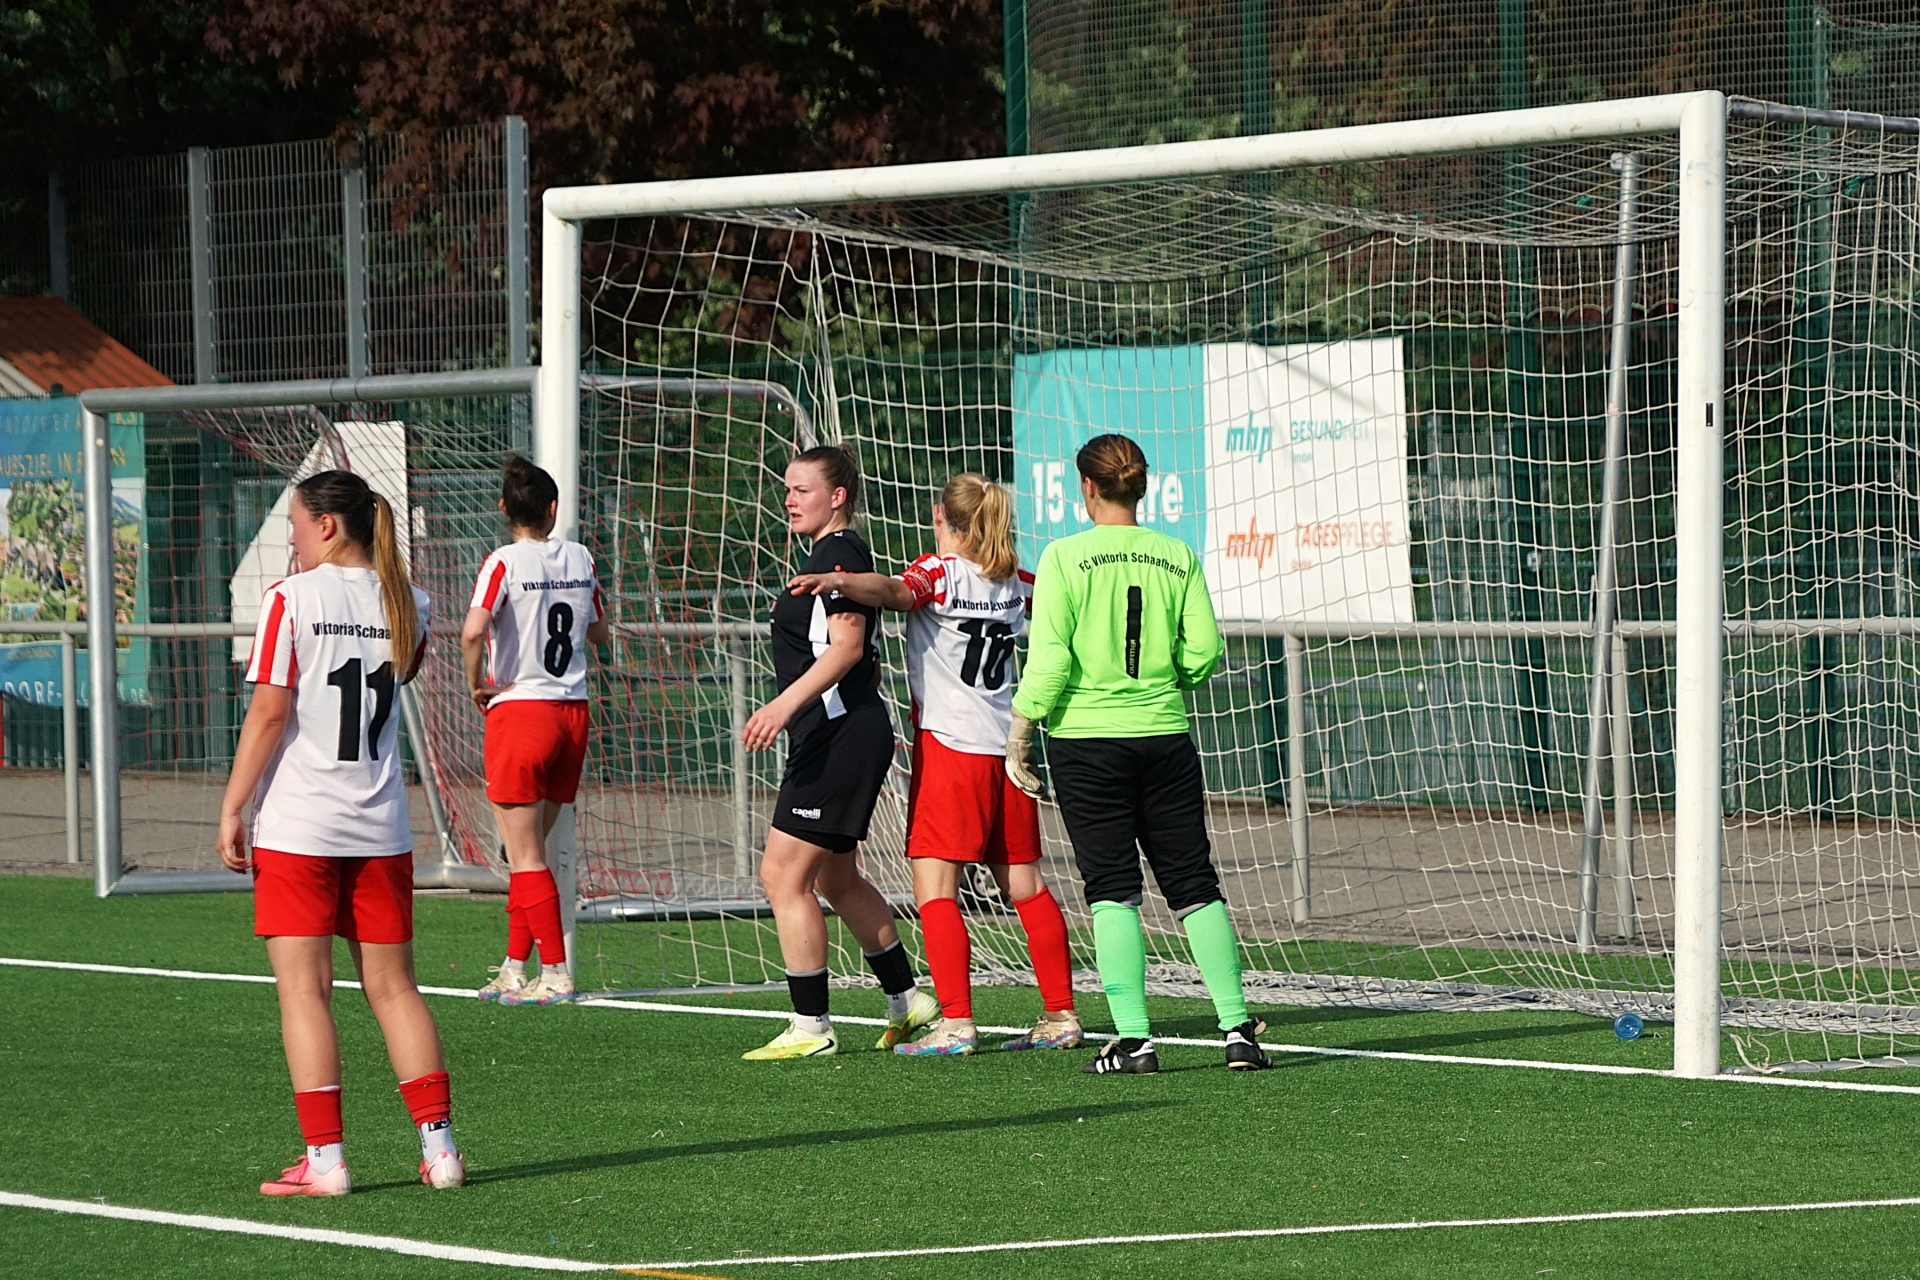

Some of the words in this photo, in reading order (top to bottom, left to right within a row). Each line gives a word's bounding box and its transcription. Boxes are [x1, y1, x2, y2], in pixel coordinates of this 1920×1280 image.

[1226, 410, 1273, 463] mhp
[1291, 418, 1369, 441] GESUNDHEIT
[1032, 462, 1066, 524] 15
[1079, 560, 1092, 573] FC
[1091, 552, 1128, 566] Viktoria
[1131, 552, 1187, 580] Schaafheim
[1226, 516, 1275, 569] mhp
[1295, 520, 1393, 548] TAGESPFLEGE
[312, 621, 354, 636] Viktoria
[952, 598, 989, 611] Viktoria
[1125, 585, 1142, 680] 1
[544, 602, 573, 678] 8
[957, 619, 1015, 690] 16
[327, 658, 395, 761] 11
